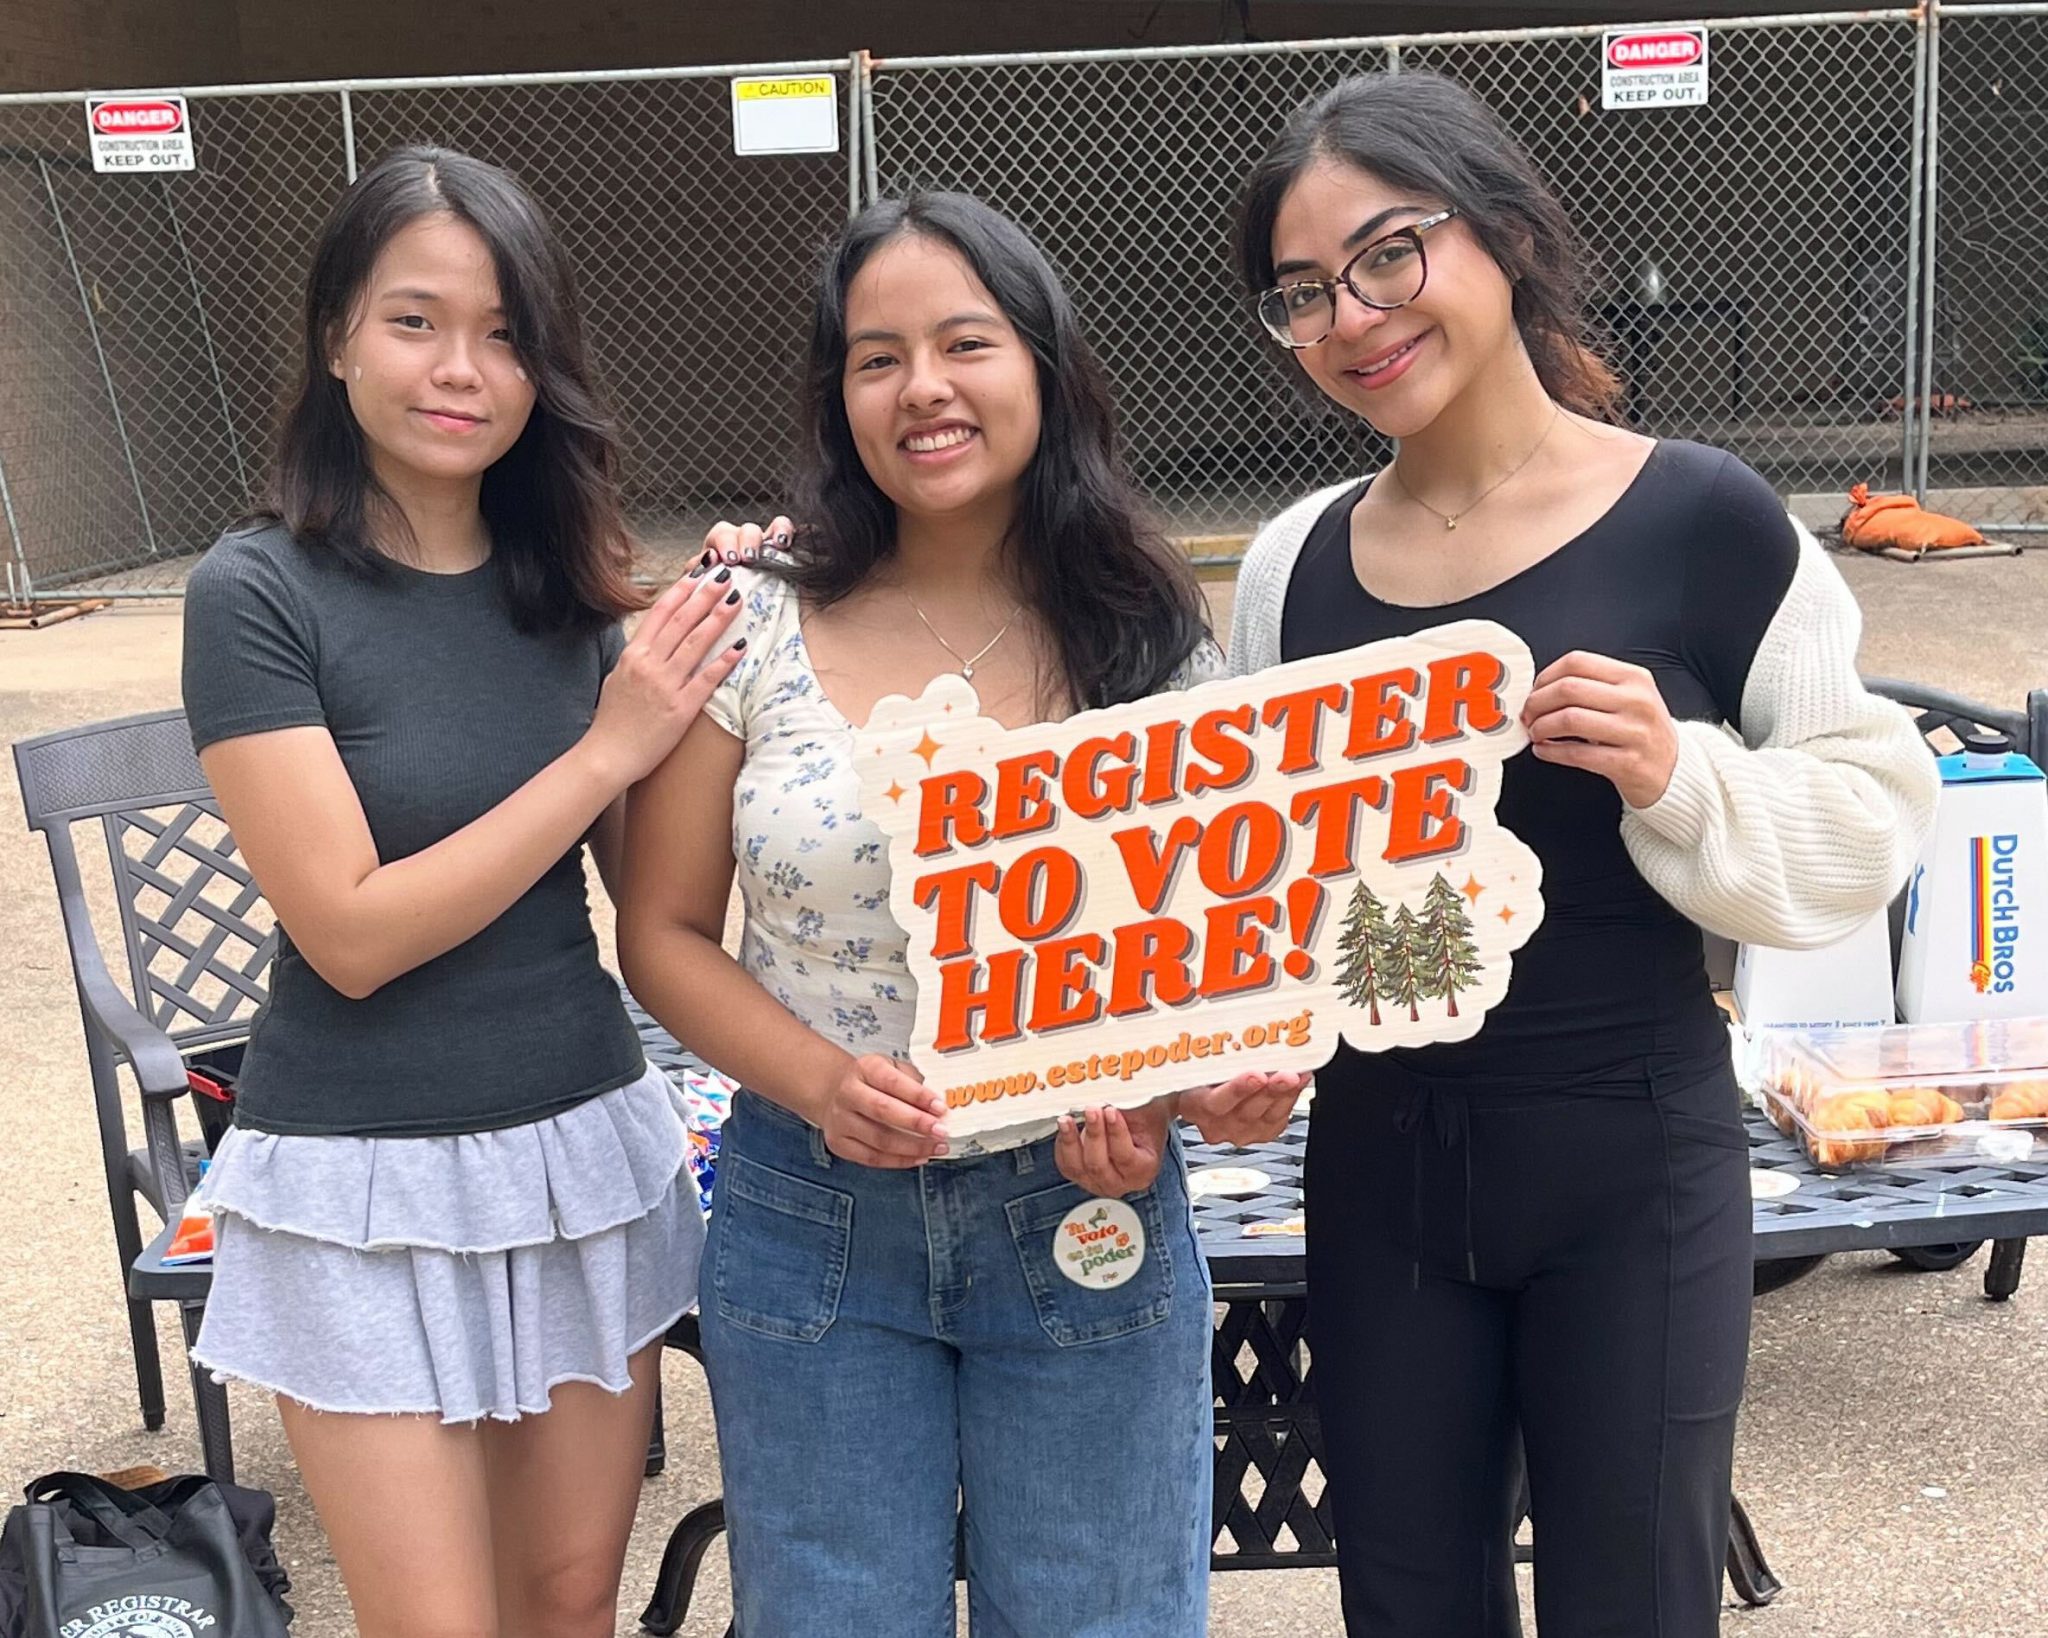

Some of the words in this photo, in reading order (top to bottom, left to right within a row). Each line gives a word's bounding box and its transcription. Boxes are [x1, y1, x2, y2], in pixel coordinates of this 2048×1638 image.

[1614, 41, 1696, 61] DANGER
[759, 81, 825, 96] CAUTION
[1610, 73, 1675, 88] CONSTRUCTION
[1678, 71, 1700, 83] AREA
[1614, 89, 1658, 103] KEEP
[1663, 87, 1696, 101] OUT
[98, 108, 177, 127] DANGER
[97, 140, 160, 151] CONSTRUCTION
[161, 139, 184, 150] AREA
[103, 154, 145, 167] KEEP
[149, 153, 182, 165] OUT
[914, 652, 1505, 859] REGISTER
[914, 847, 1080, 959] TO
[1112, 759, 1469, 914] VOTE
[932, 879, 1323, 1053] HERE!
[1993, 926, 2019, 994] BROS
[945, 1008, 1313, 1110] www.estepoder.org
[1076, 1223, 1119, 1245] voto
[1081, 1245, 1136, 1276] poder
[86, 1594, 216, 1631] REGISTRAR
